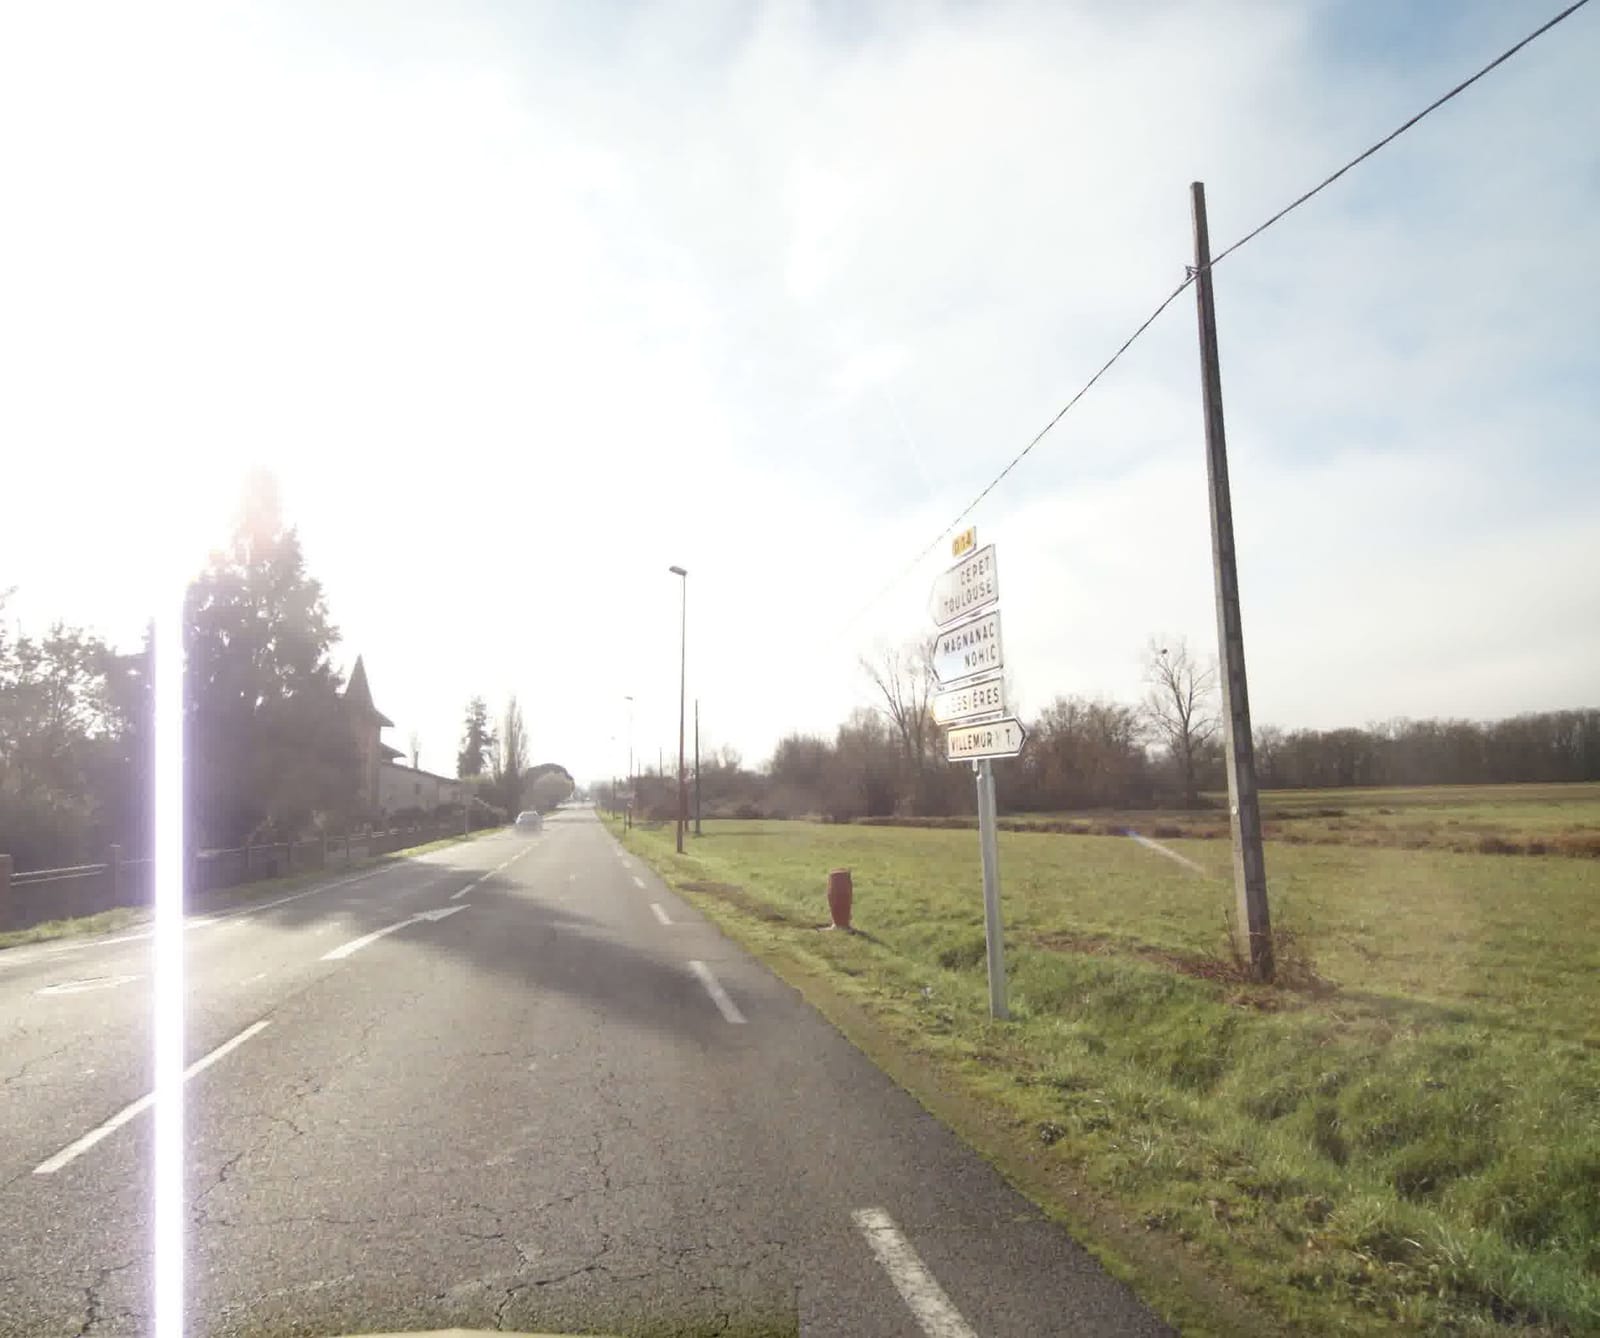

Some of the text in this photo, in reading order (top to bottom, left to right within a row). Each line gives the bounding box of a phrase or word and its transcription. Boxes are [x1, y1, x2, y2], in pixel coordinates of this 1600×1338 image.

[961, 555, 990, 586] CEPET
[944, 578, 992, 614] TOULOUSE
[944, 621, 994, 655] MAGNANAC
[965, 643, 996, 667] NOHIC
[945, 686, 999, 714] ESSIÈRES
[951, 731, 992, 752] VILLEMUR
